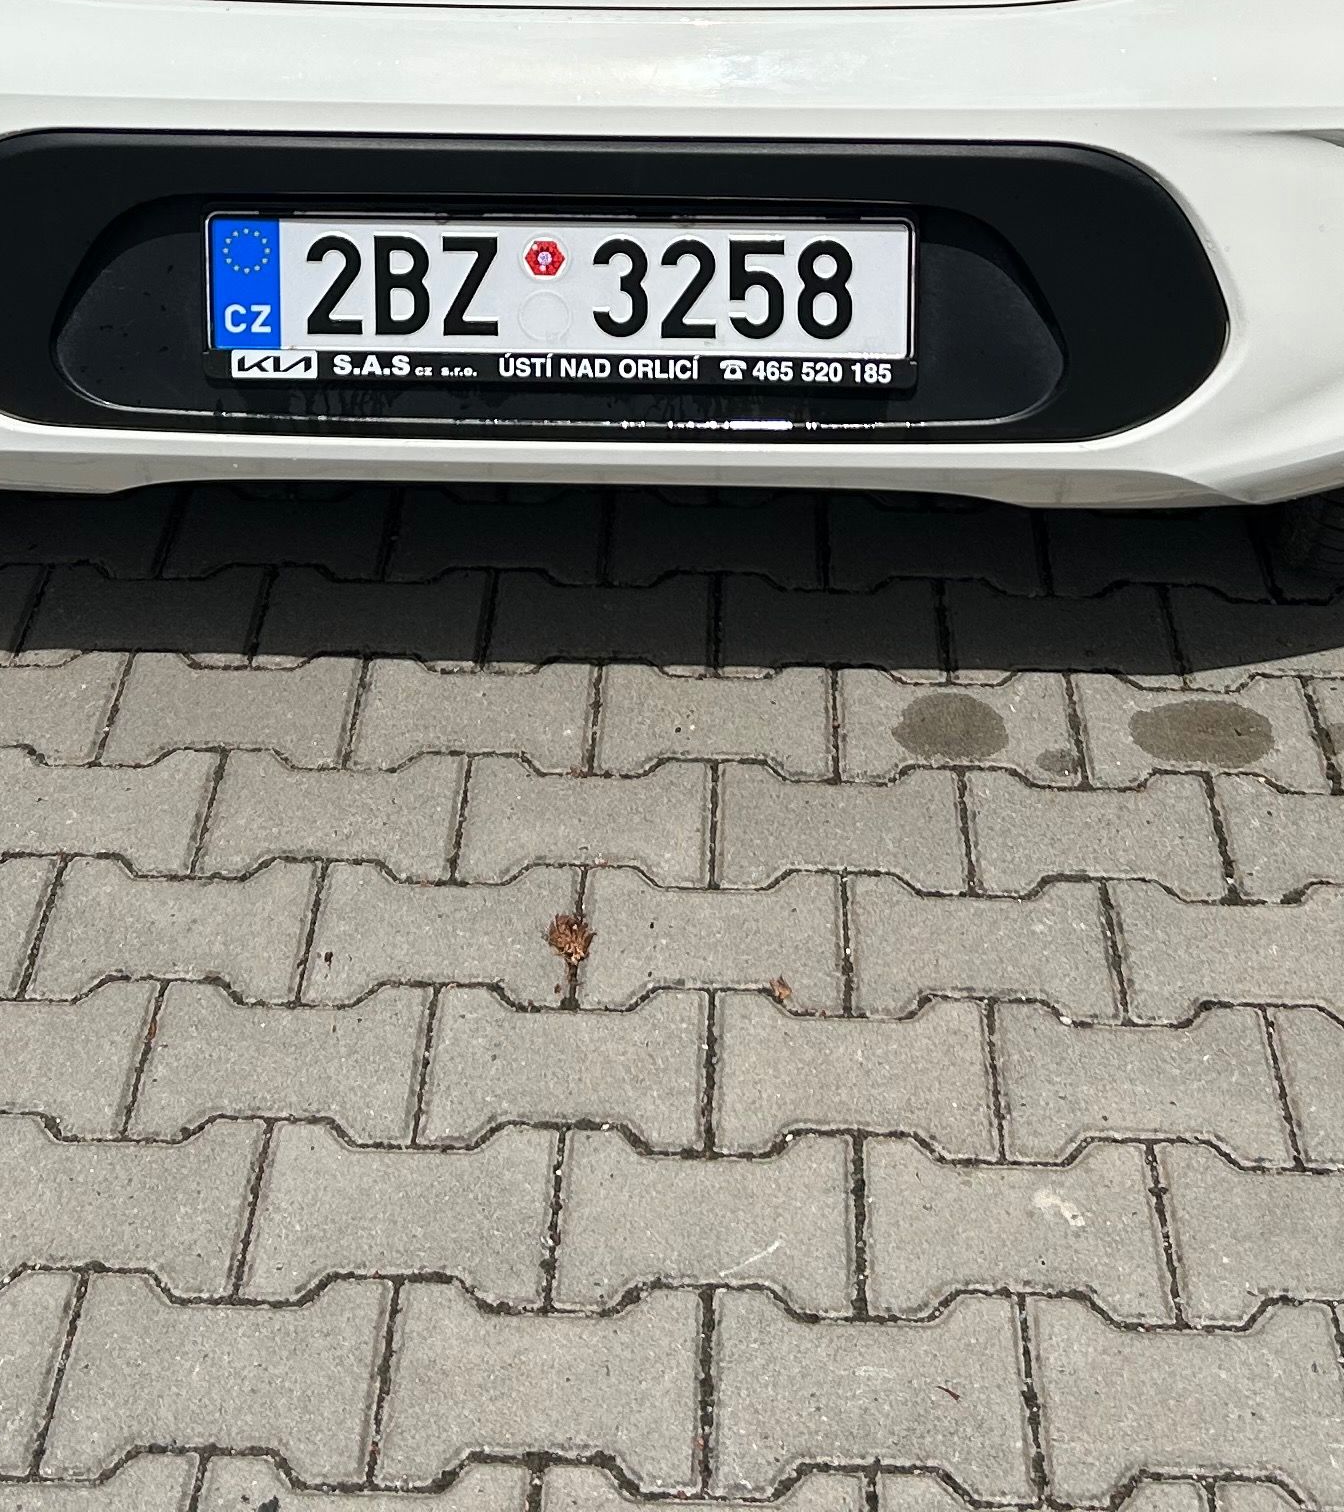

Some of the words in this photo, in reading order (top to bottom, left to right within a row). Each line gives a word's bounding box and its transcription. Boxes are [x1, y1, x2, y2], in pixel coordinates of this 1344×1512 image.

[306, 234, 499, 337] 2BZ
[592, 237, 854, 340] 3258
[224, 304, 272, 334] CZ
[498, 353, 552, 378] ÚSTÍ
[559, 358, 611, 379] NAD
[618, 354, 700, 380] ORLICÍ
[752, 360, 794, 381] 465
[801, 361, 843, 382] 520
[851, 362, 892, 384] 185
